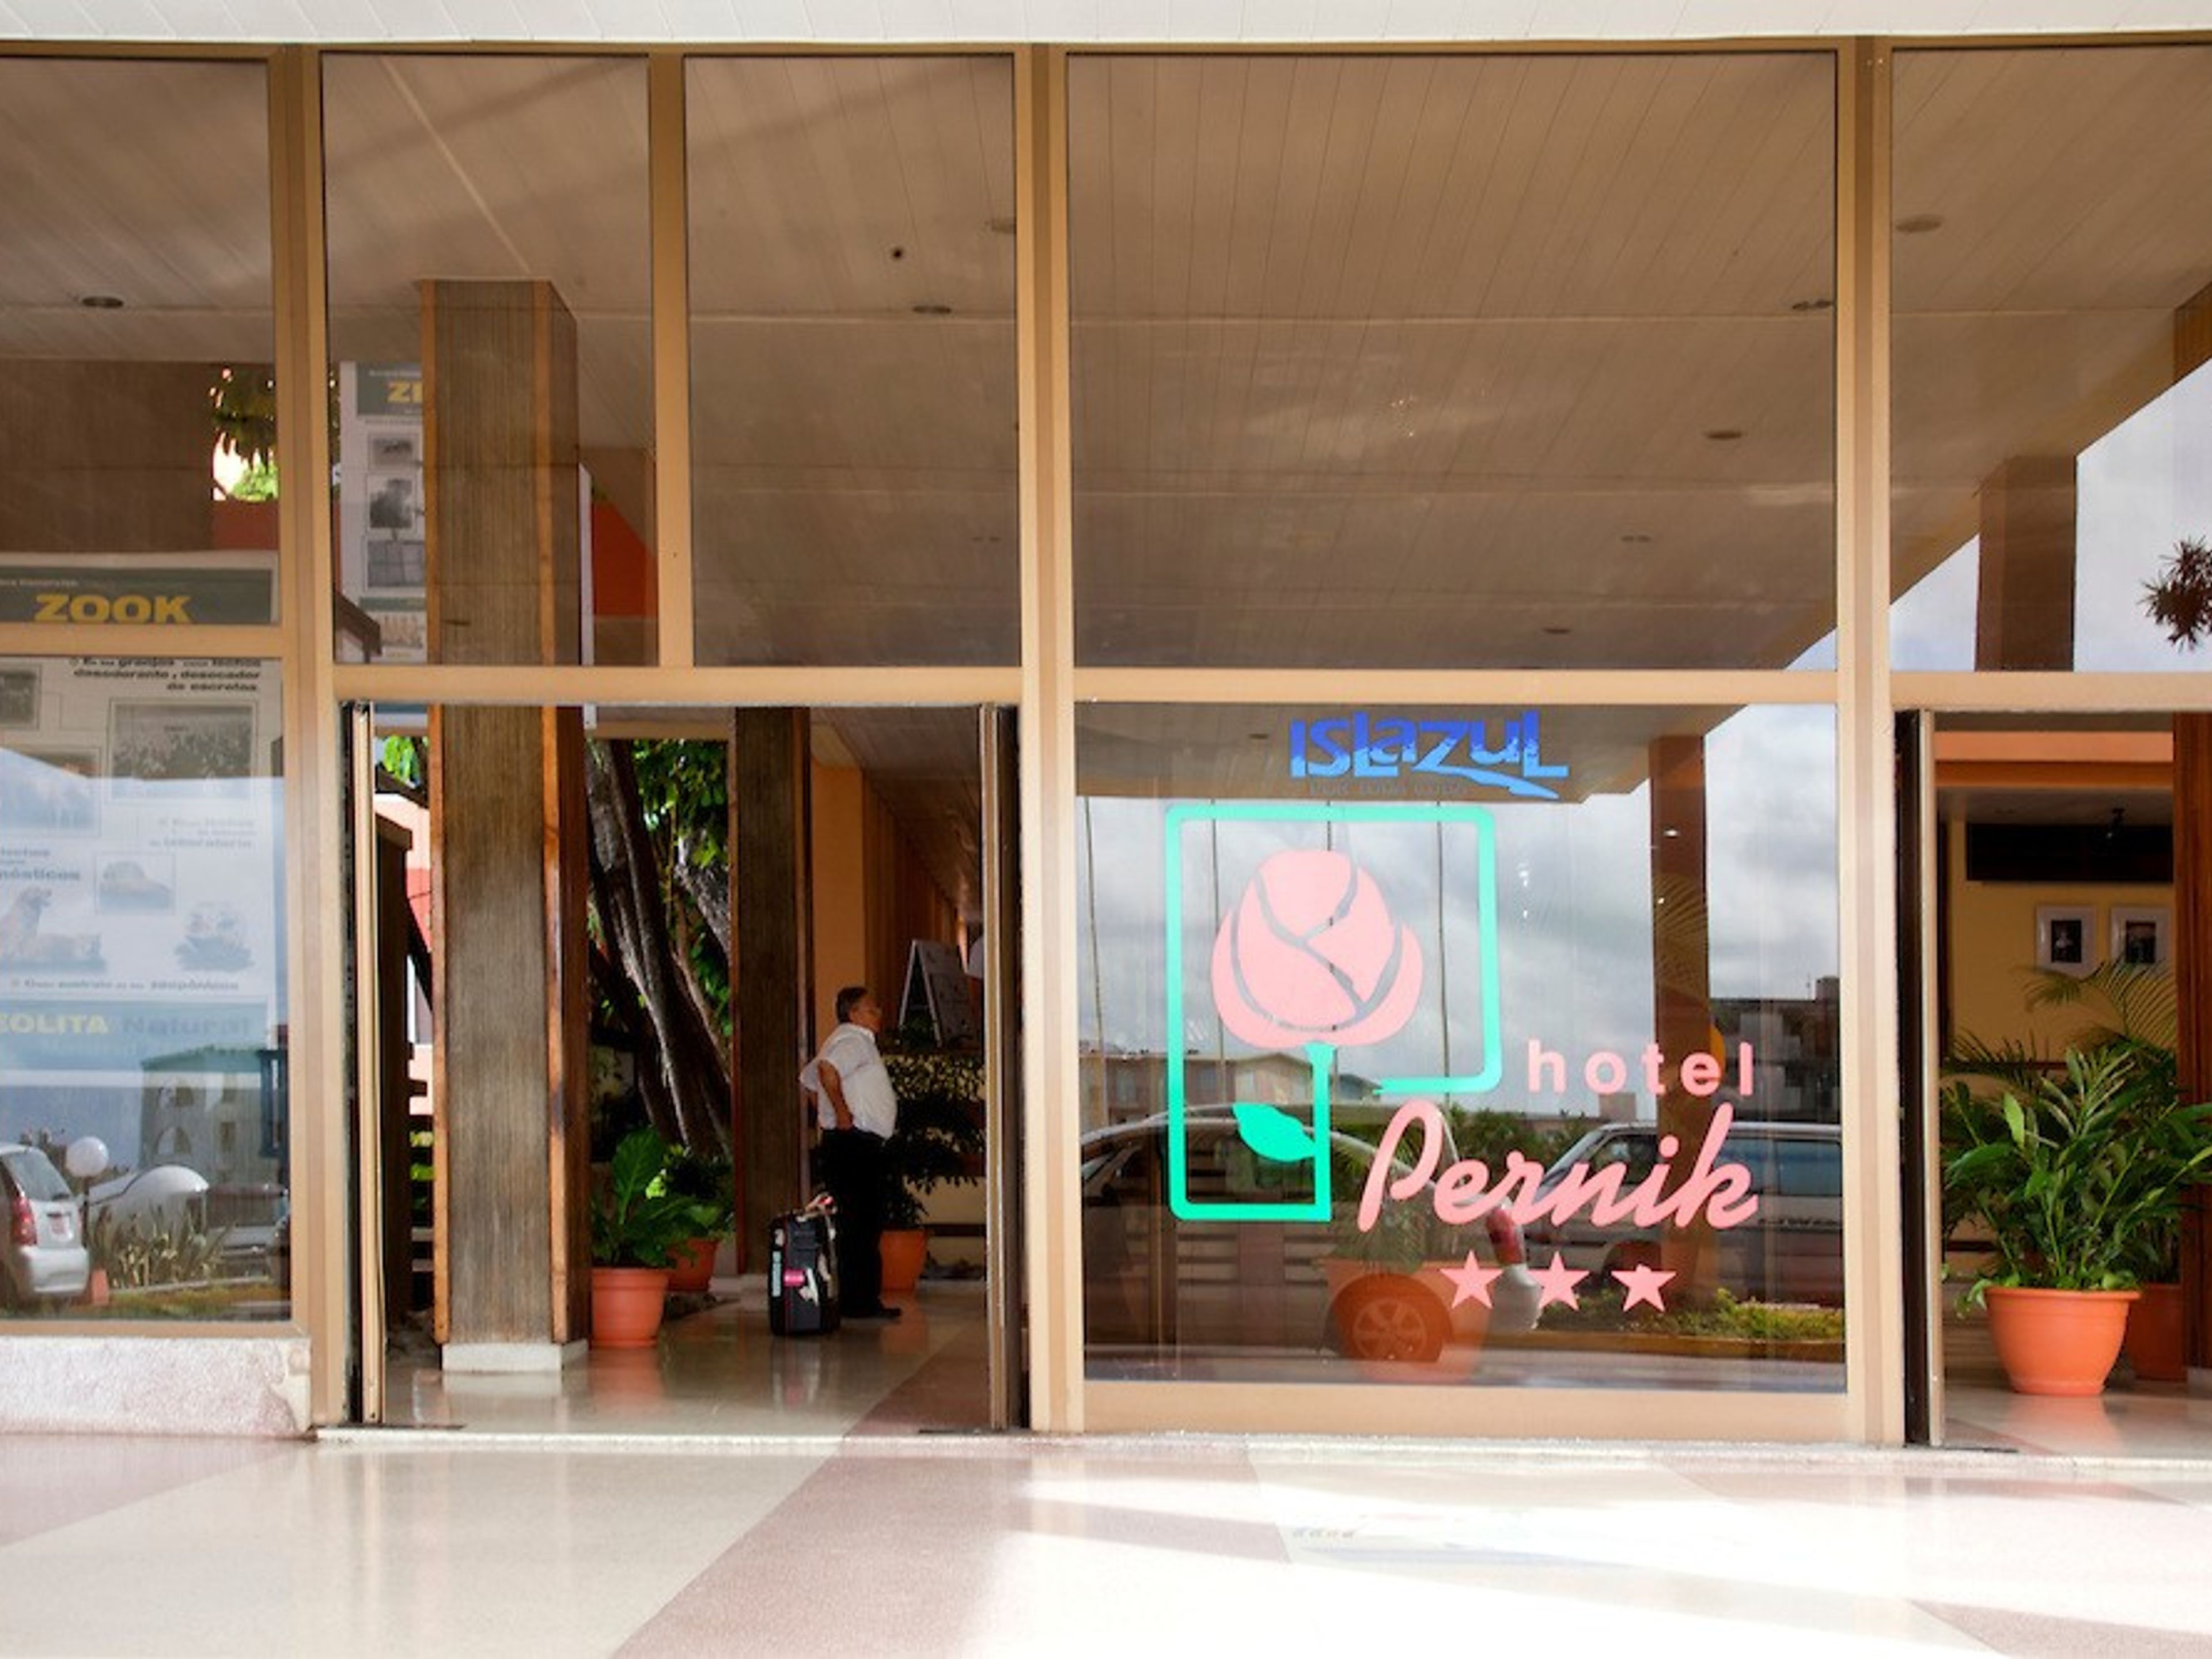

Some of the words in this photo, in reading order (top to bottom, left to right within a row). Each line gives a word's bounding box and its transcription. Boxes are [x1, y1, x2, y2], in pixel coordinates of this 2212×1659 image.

[34, 593, 192, 623] ZOOK
[123, 1014, 249, 1035] Natural
[1528, 1039, 1753, 1096] hotel
[1357, 1099, 1759, 1233] Pernik
